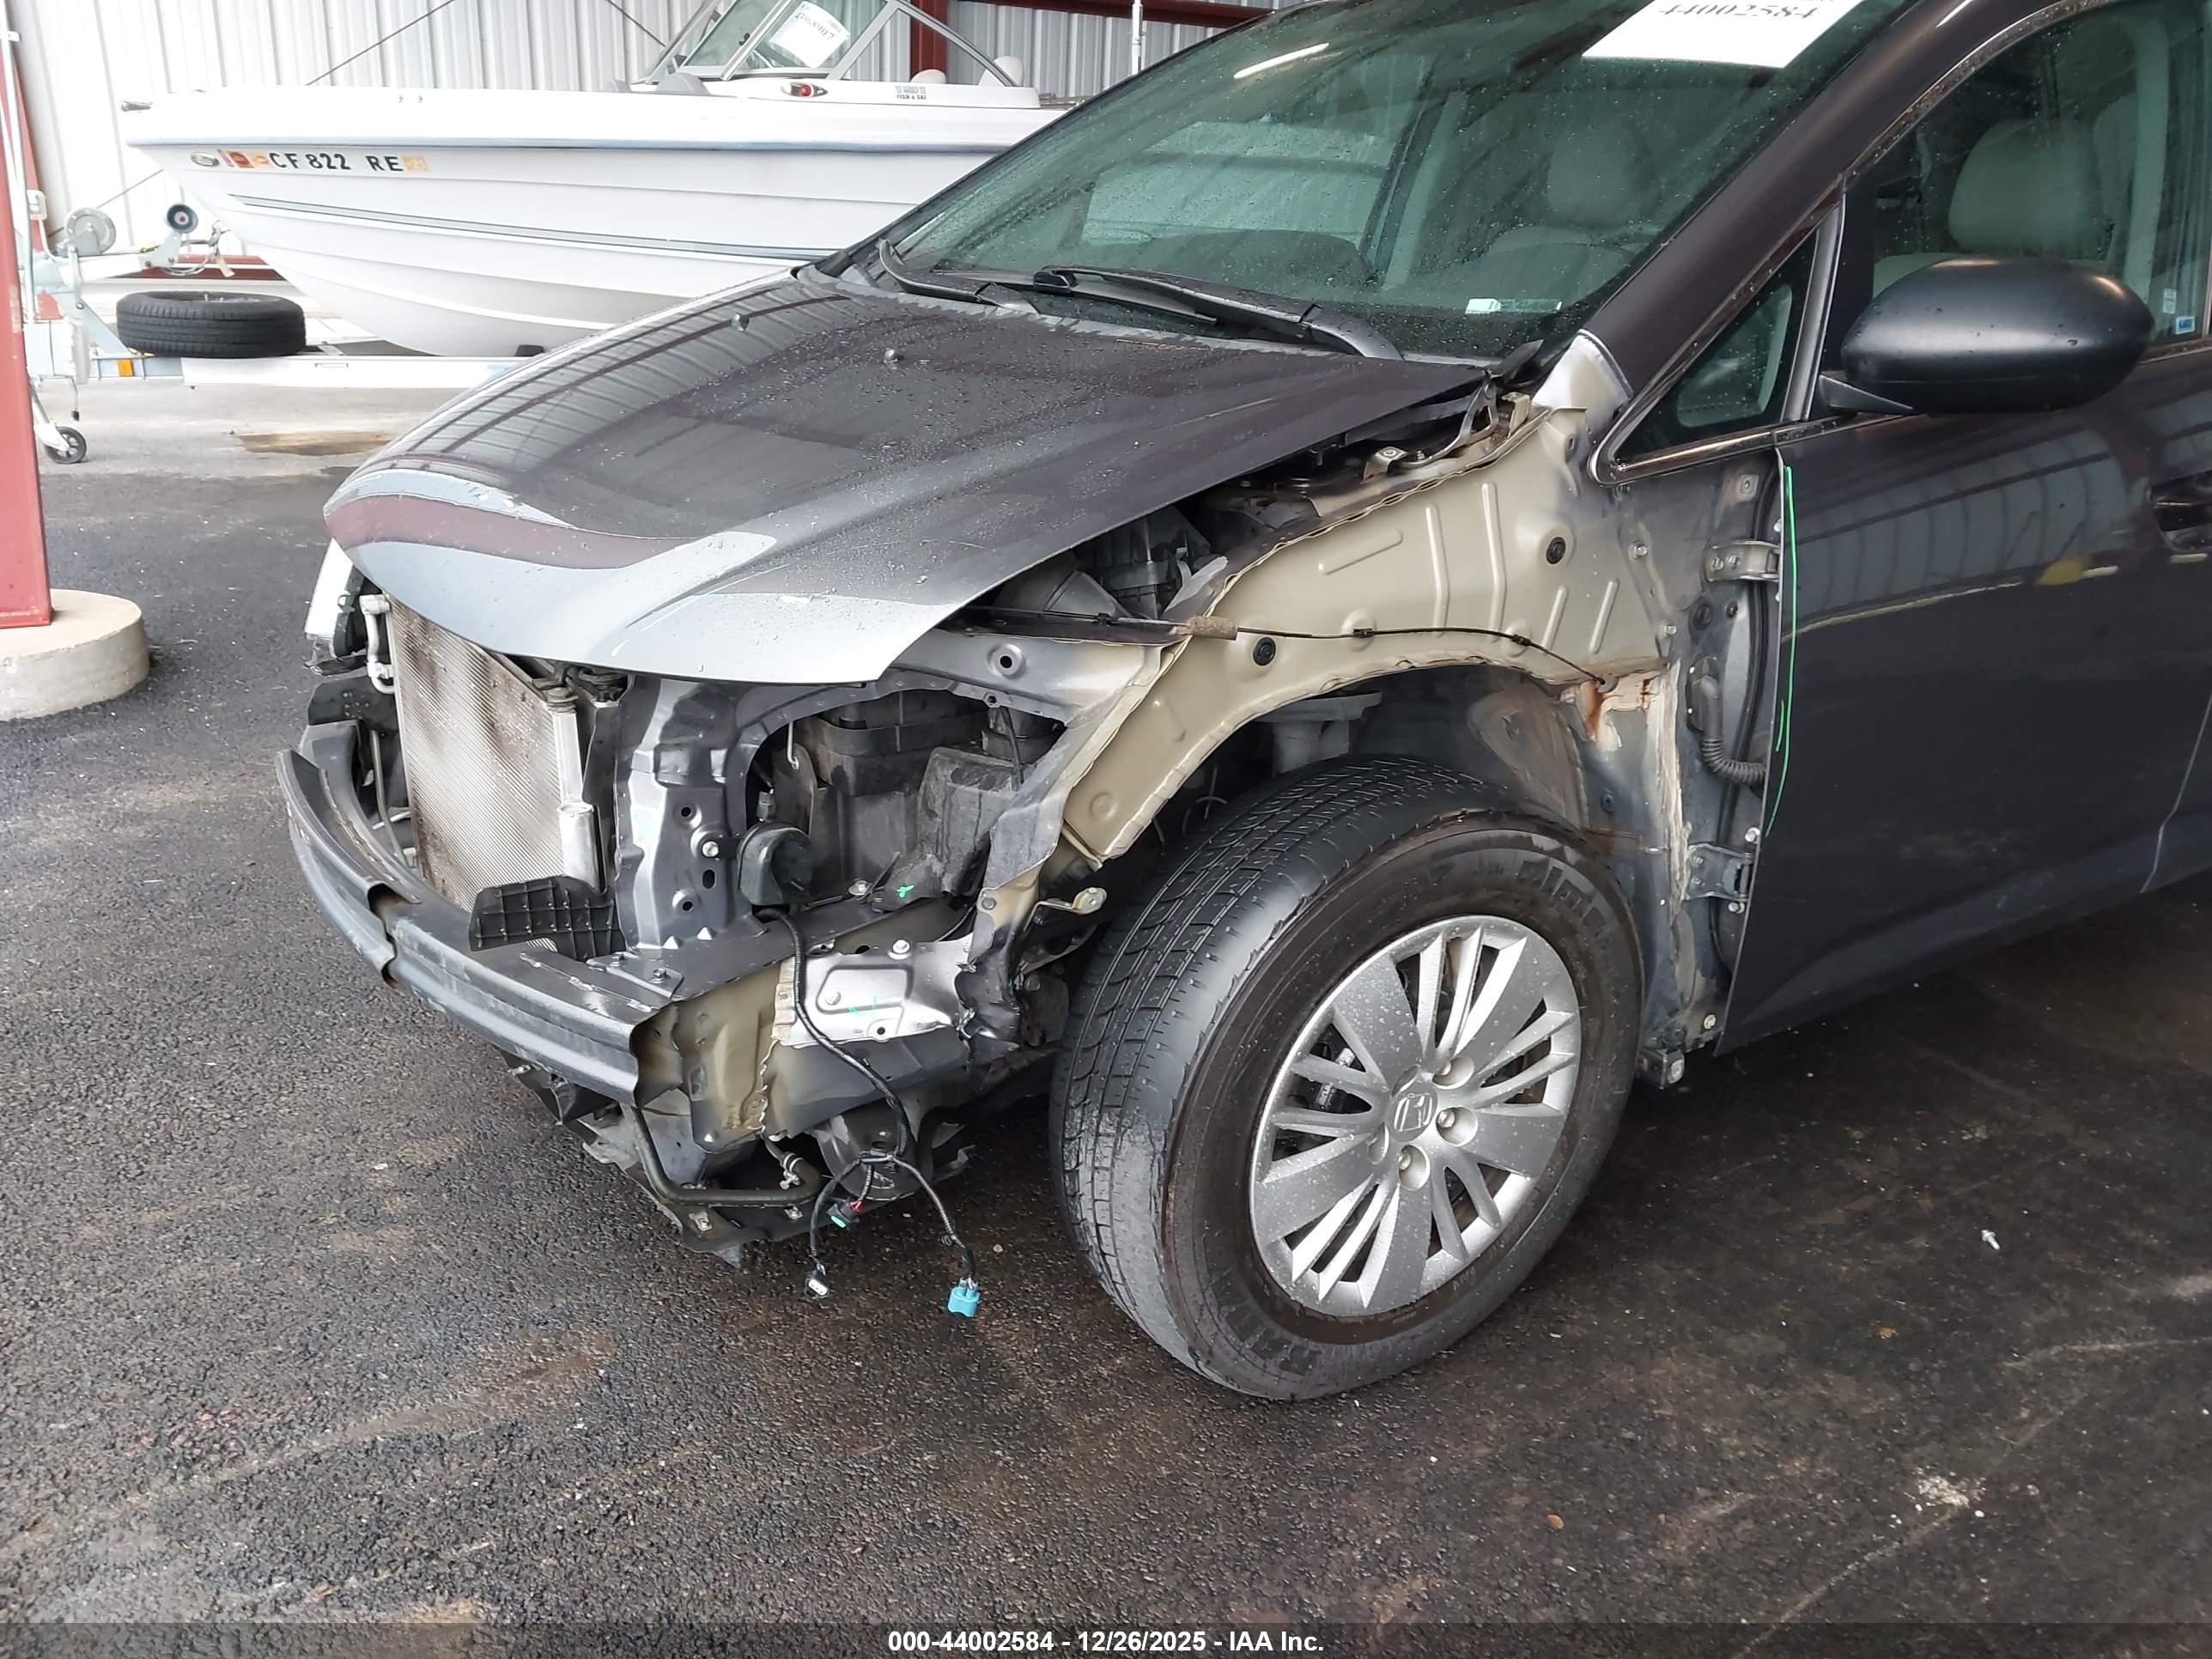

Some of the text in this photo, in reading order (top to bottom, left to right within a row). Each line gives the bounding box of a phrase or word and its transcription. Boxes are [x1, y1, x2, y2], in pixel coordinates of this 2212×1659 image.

[1658, 3, 1819, 19] 44002584
[269, 152, 404, 172] CF 822 RE
